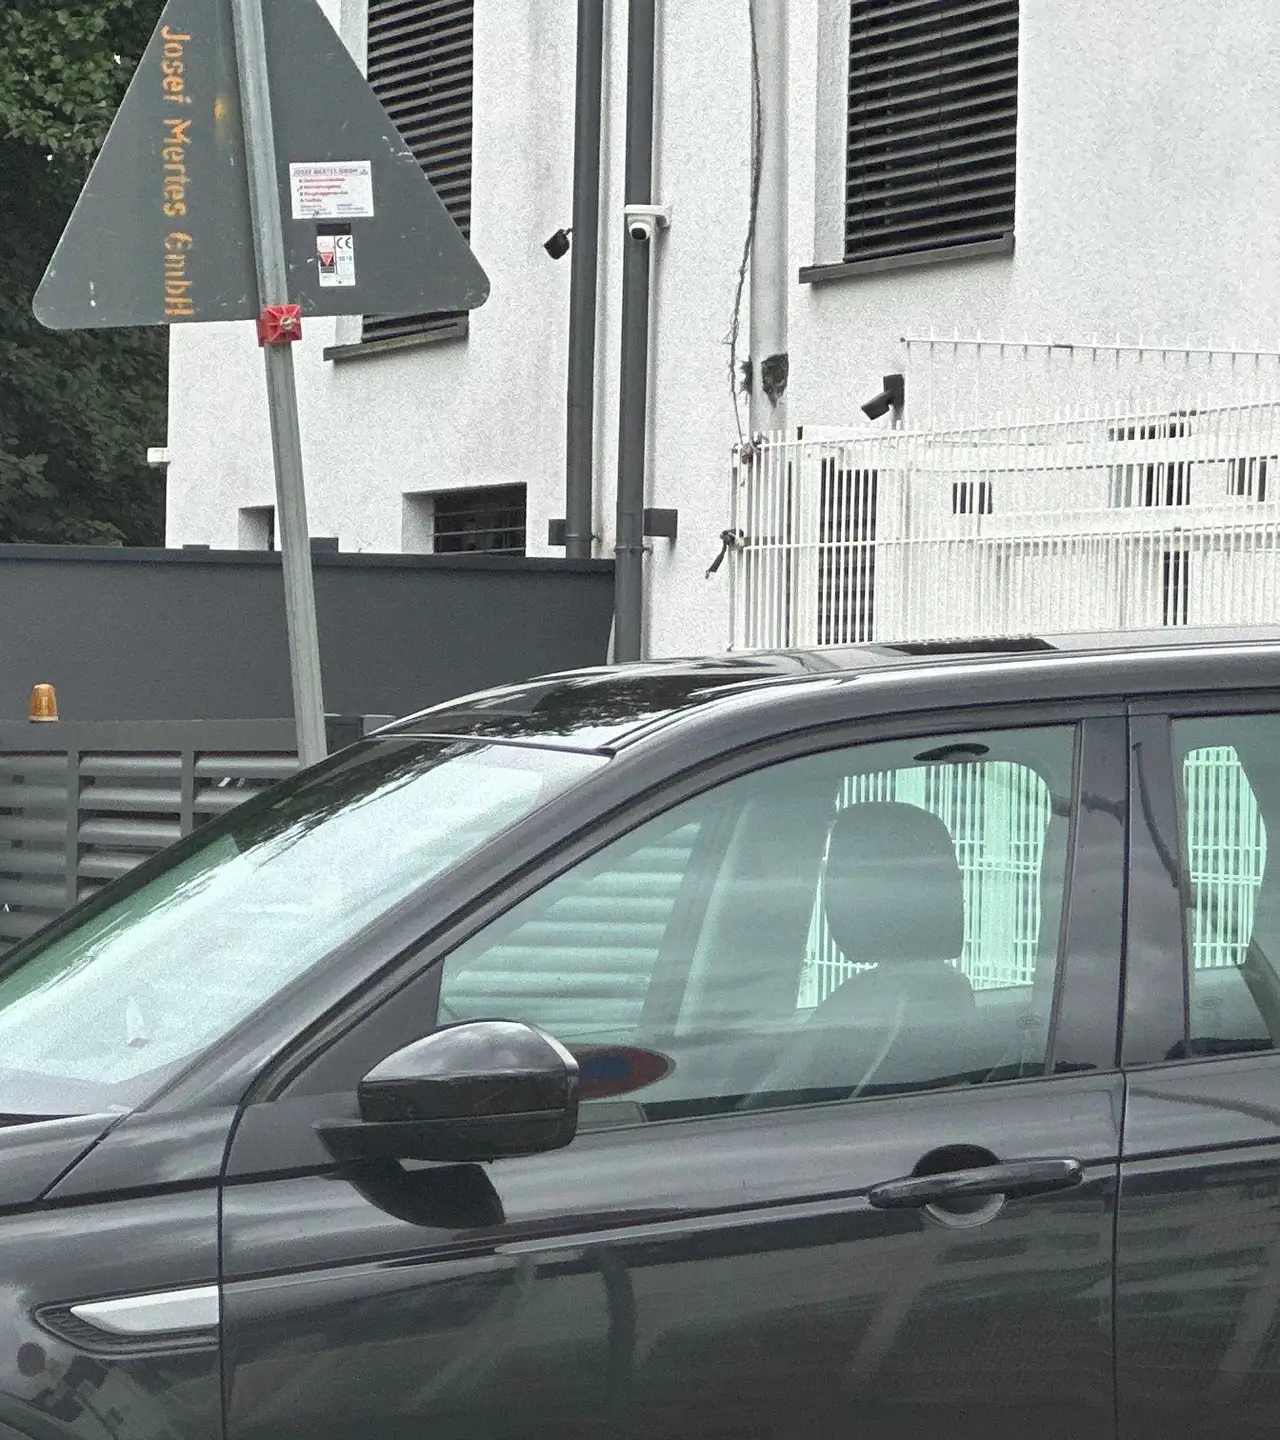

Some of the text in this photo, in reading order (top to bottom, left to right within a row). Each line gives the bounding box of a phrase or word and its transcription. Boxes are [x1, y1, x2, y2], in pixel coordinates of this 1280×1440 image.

[162, 119, 192, 216] Mertes
[164, 232, 195, 315] GmbH
[337, 237, 353, 249] CE
